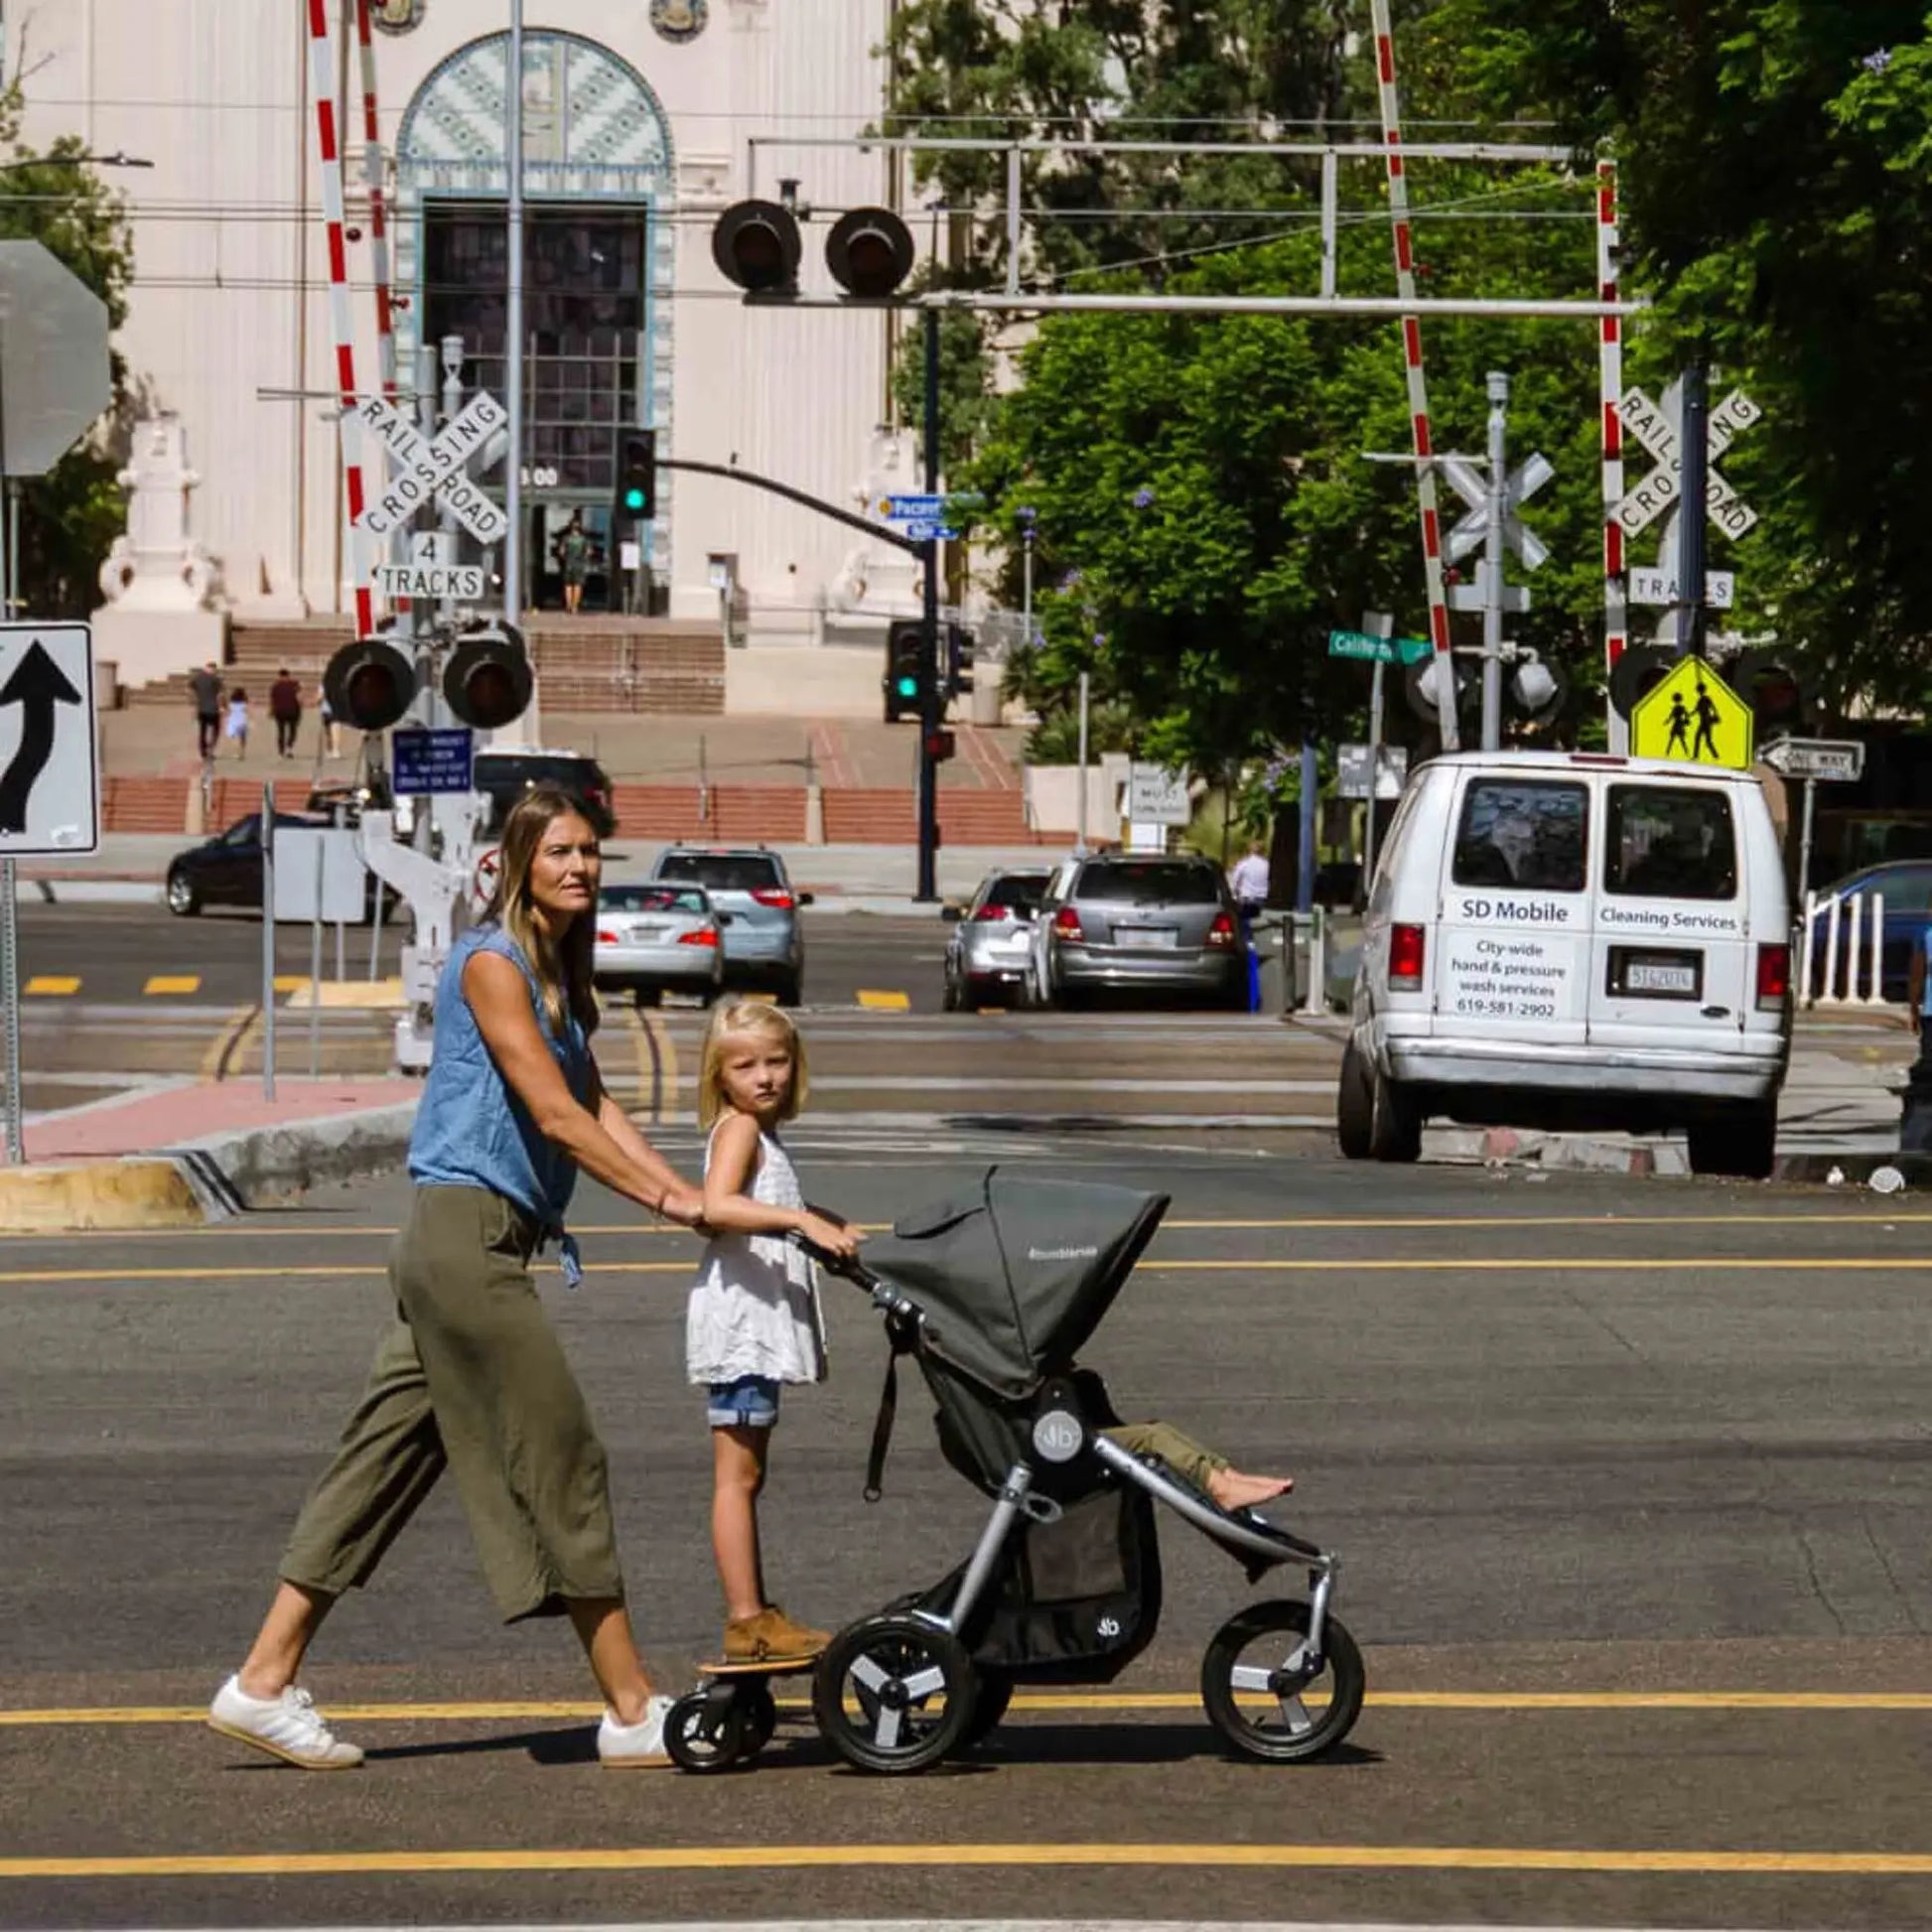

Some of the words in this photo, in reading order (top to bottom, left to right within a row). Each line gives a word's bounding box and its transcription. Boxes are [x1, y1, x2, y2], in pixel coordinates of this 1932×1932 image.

[366, 402, 496, 533] CROSSING
[421, 535, 436, 561] 4
[383, 568, 478, 596] TRACKS
[1638, 578, 1727, 599] TRAS
[1462, 899, 1491, 918] SD
[1496, 901, 1569, 922] Mobile
[1600, 907, 1669, 929] Cleaning
[1672, 911, 1736, 929] Services
[1451, 958, 1489, 973] hand
[1491, 962, 1502, 974] &
[1504, 964, 1566, 979] pressure
[1459, 980, 1496, 993] wash
[1499, 983, 1556, 996] services
